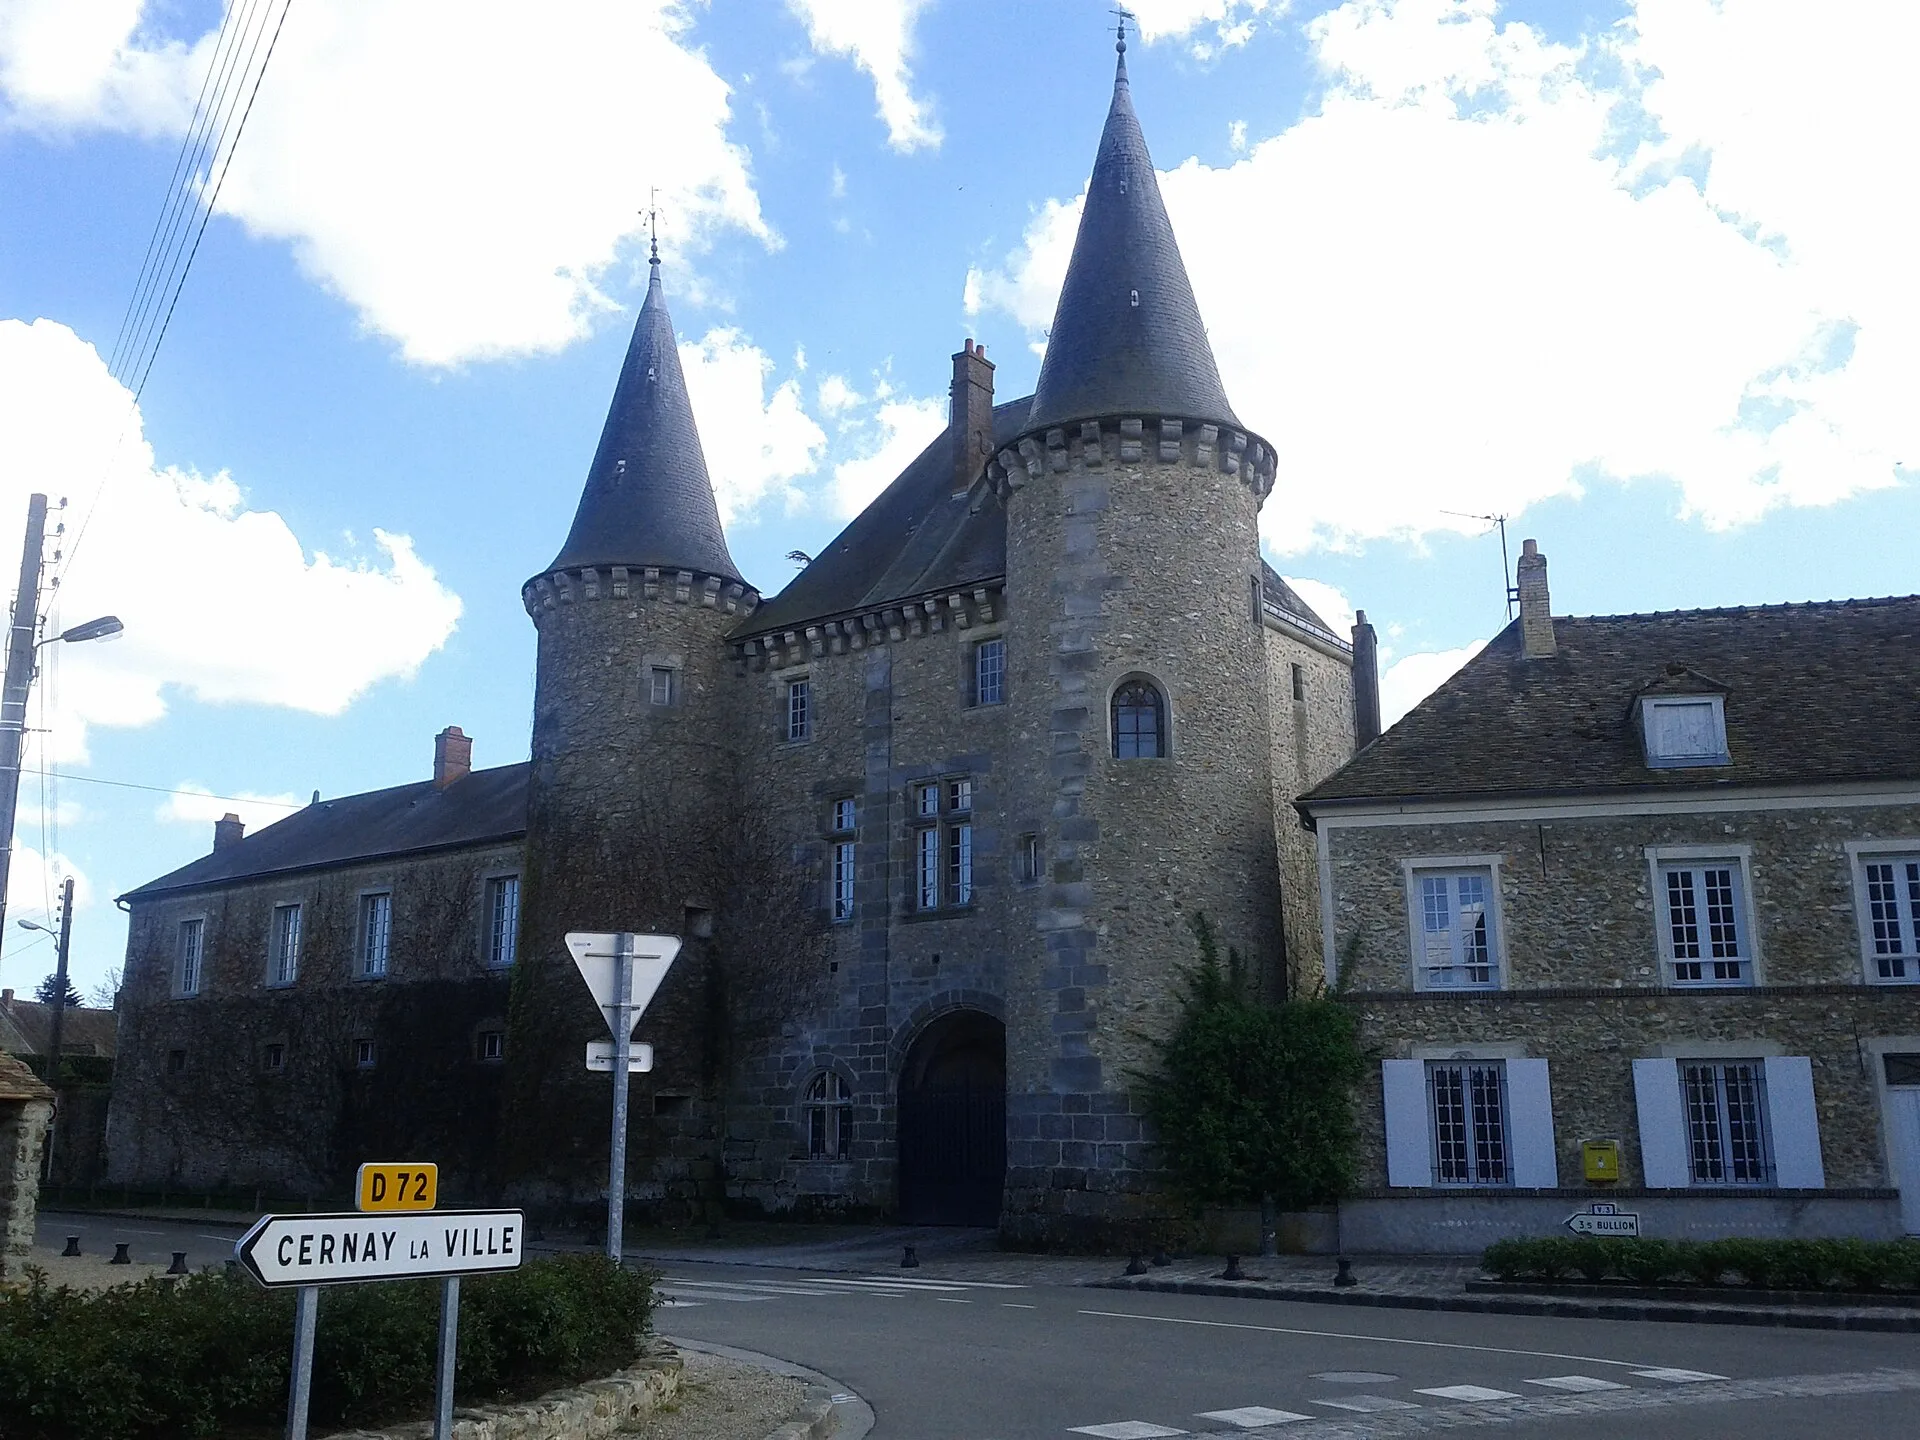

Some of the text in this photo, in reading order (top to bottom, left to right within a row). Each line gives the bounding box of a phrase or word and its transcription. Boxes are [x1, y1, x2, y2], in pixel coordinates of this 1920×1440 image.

[371, 1173, 428, 1201] D 72
[1597, 1221, 1635, 1230] BULLION
[277, 1226, 514, 1266] CERNAY LA VILLE
